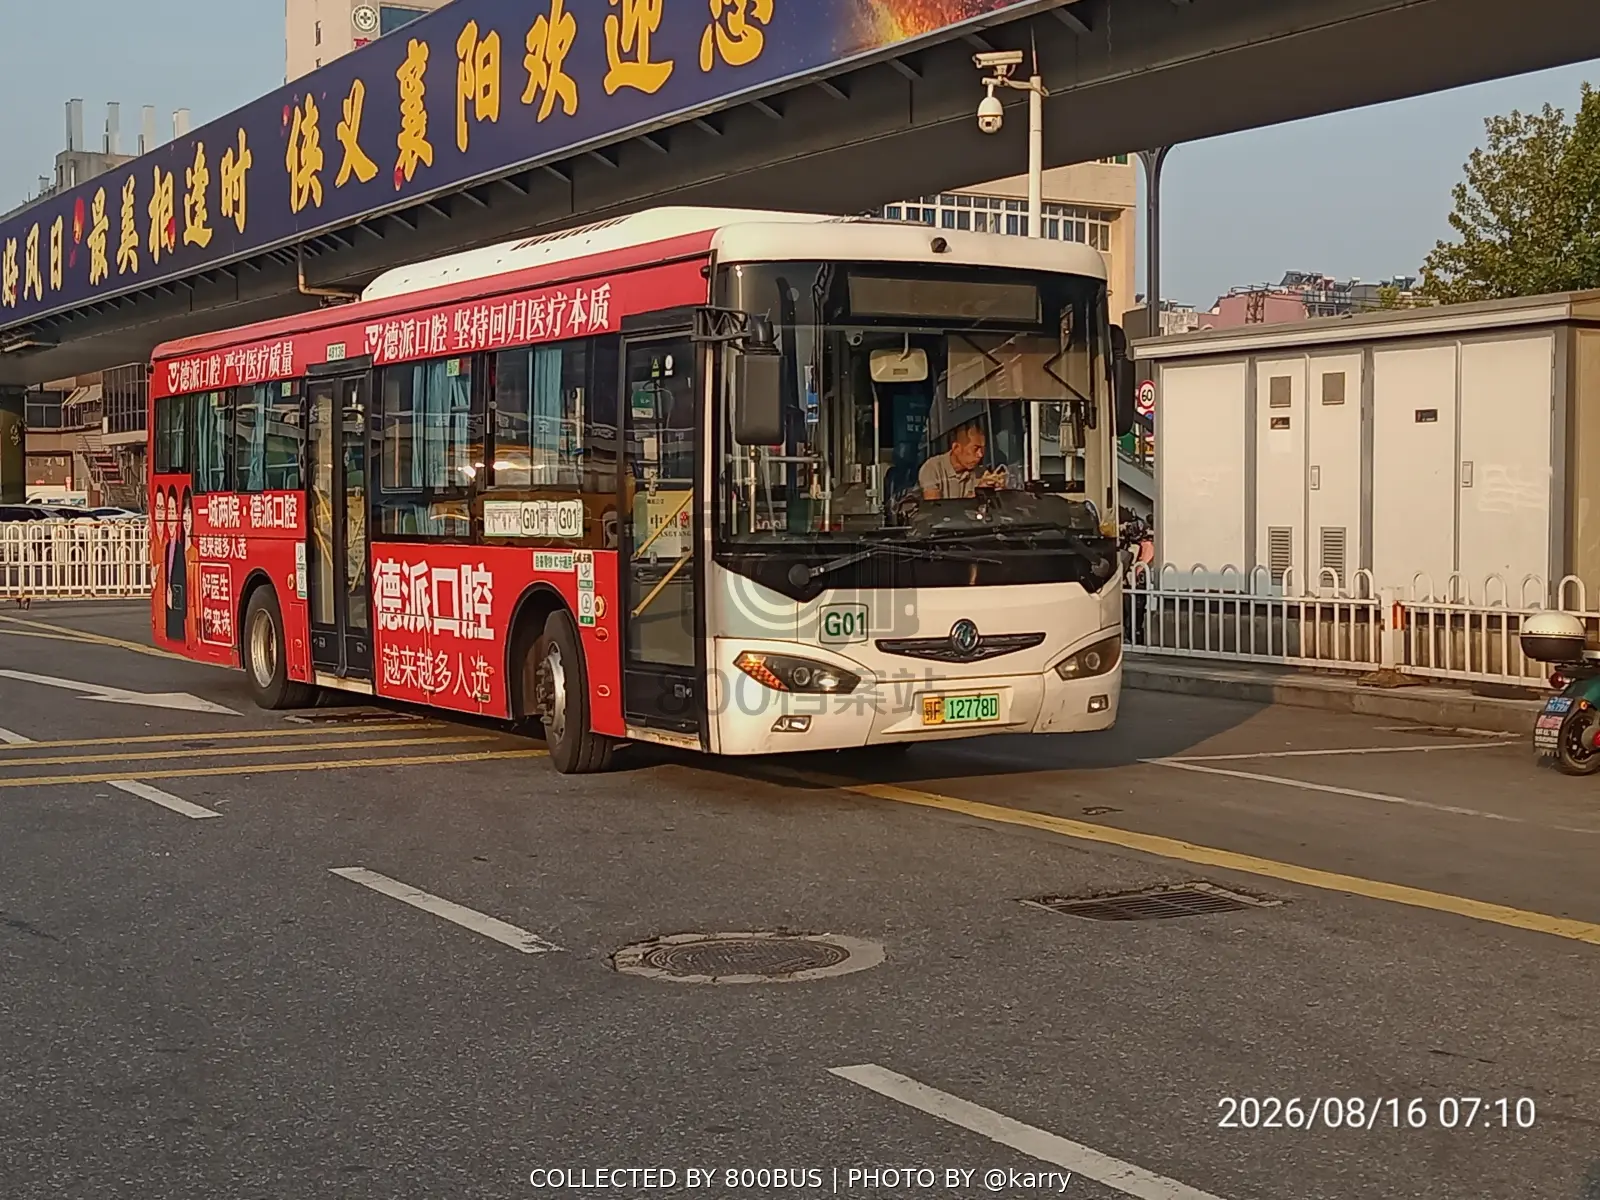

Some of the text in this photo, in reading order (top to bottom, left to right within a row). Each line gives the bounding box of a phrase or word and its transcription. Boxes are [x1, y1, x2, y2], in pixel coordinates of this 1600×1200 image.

[383, 282, 612, 362] 德派口腔 坚持回归医疗本质
[179, 353, 221, 393] 德派口腔
[1141, 389, 1153, 402] 60
[522, 507, 540, 530] G01
[559, 507, 578, 530] G01
[201, 571, 230, 601] 好医生
[372, 557, 496, 641] 德派口腔
[824, 611, 866, 637] G01
[382, 642, 492, 704] 越来越多人选
[949, 697, 998, 720] 12778D
